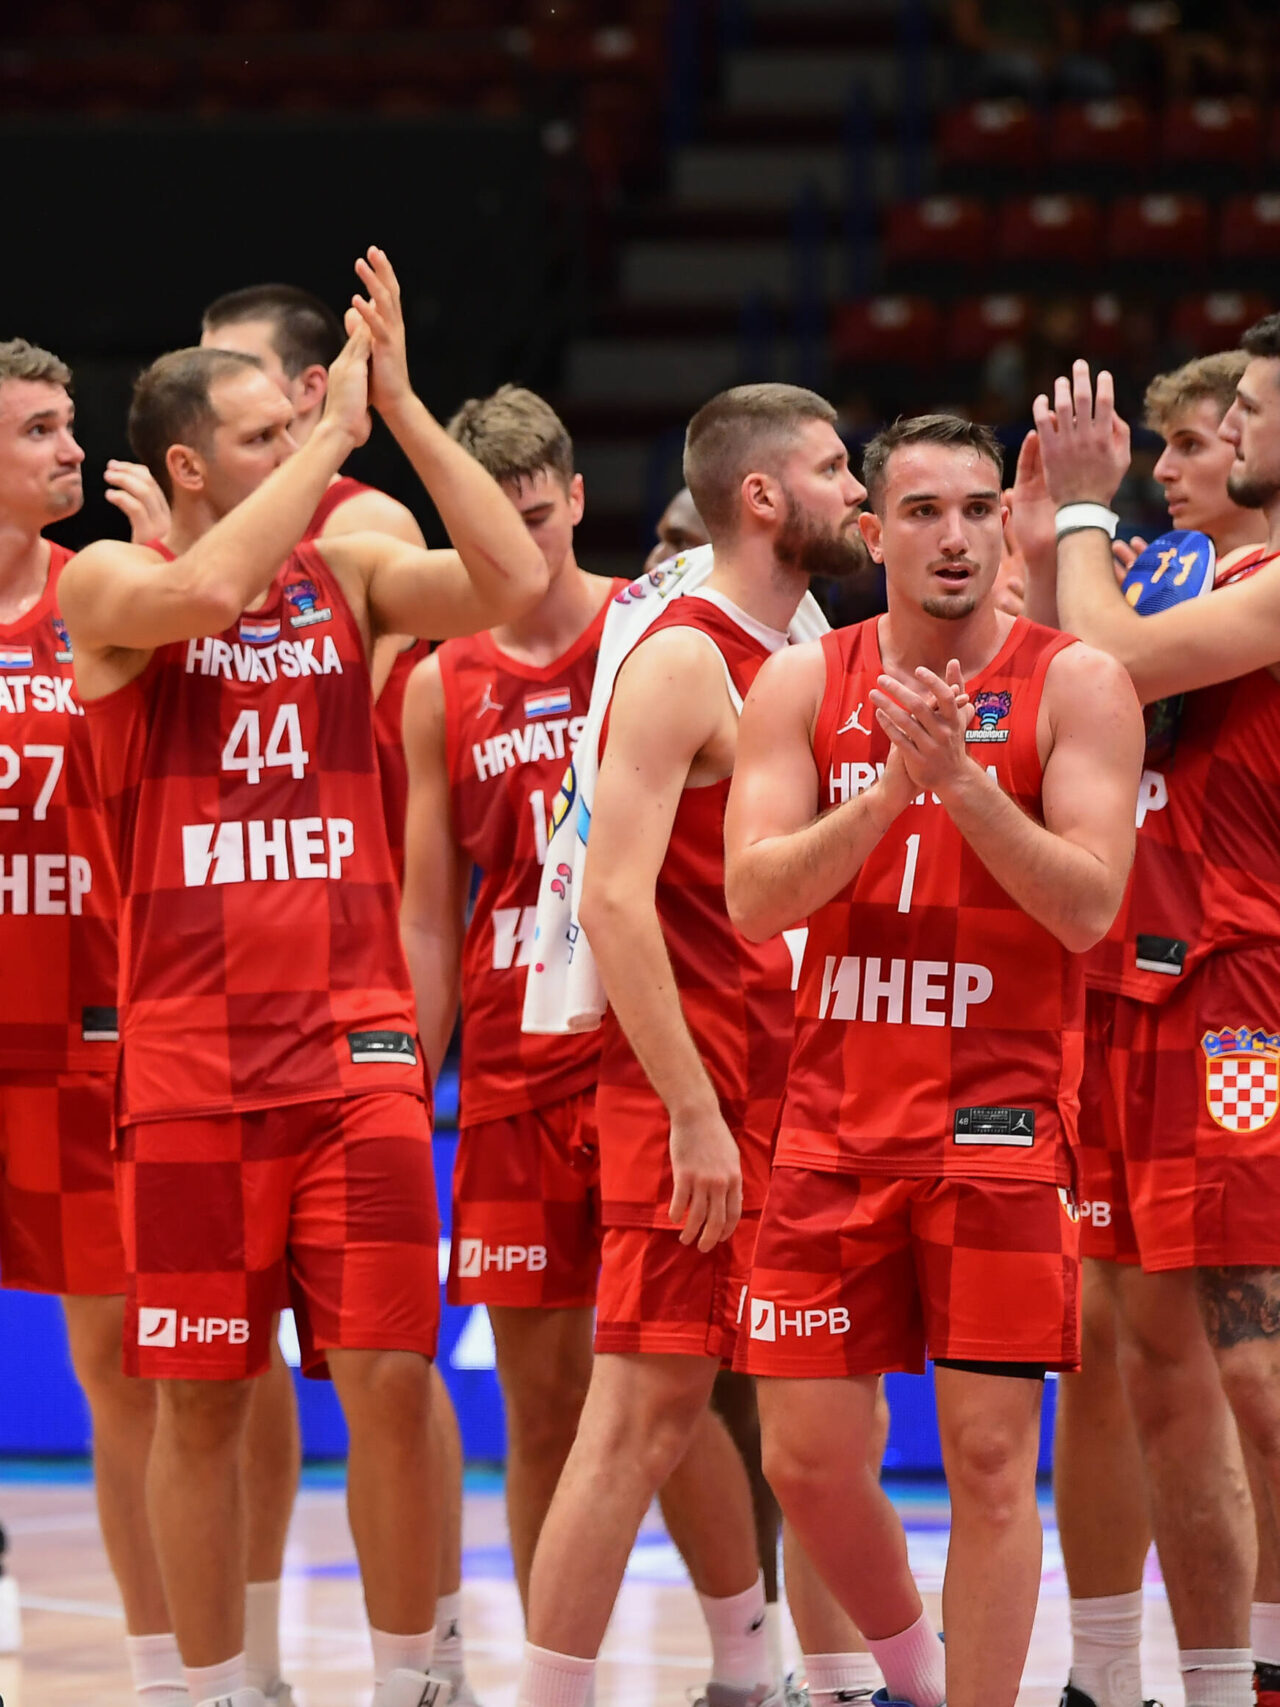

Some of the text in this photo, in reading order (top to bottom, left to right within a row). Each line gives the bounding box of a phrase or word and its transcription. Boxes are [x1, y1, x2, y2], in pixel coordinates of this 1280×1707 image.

[185, 635, 343, 684] HRVATSKA
[221, 703, 309, 785] 44
[248, 817, 355, 881] HEP
[897, 833, 921, 914] 1
[862, 957, 994, 1028] HEP
[482, 1245, 547, 1272] HPB
[180, 1316, 250, 1345] HPB
[780, 1307, 851, 1337] HPB
